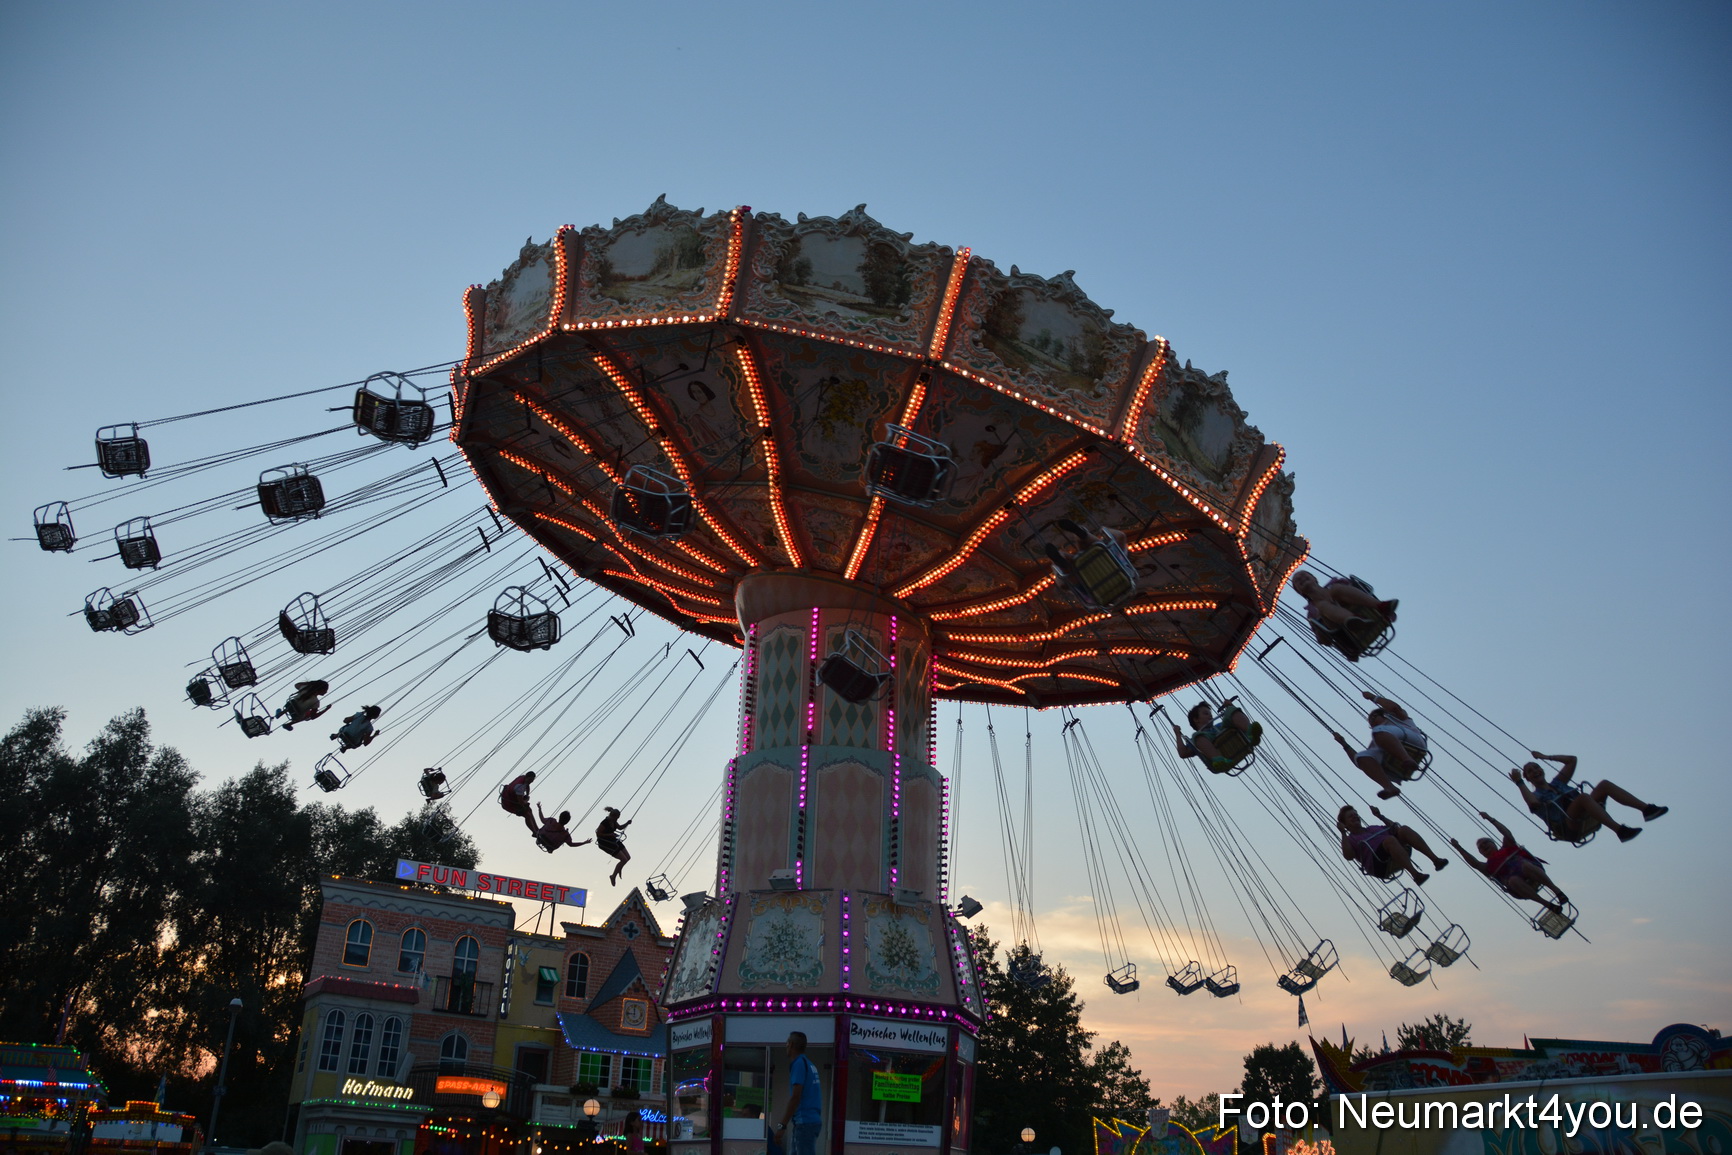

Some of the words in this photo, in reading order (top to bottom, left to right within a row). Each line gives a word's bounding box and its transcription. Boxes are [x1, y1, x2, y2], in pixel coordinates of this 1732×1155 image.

[417, 864, 467, 887] FUN
[476, 873, 570, 903] STREET
[500, 943, 514, 1014] HOTEL
[851, 1022, 896, 1040] Bayrischer
[900, 1028, 946, 1048] Wellenflug
[341, 1078, 415, 1101] Hofmann
